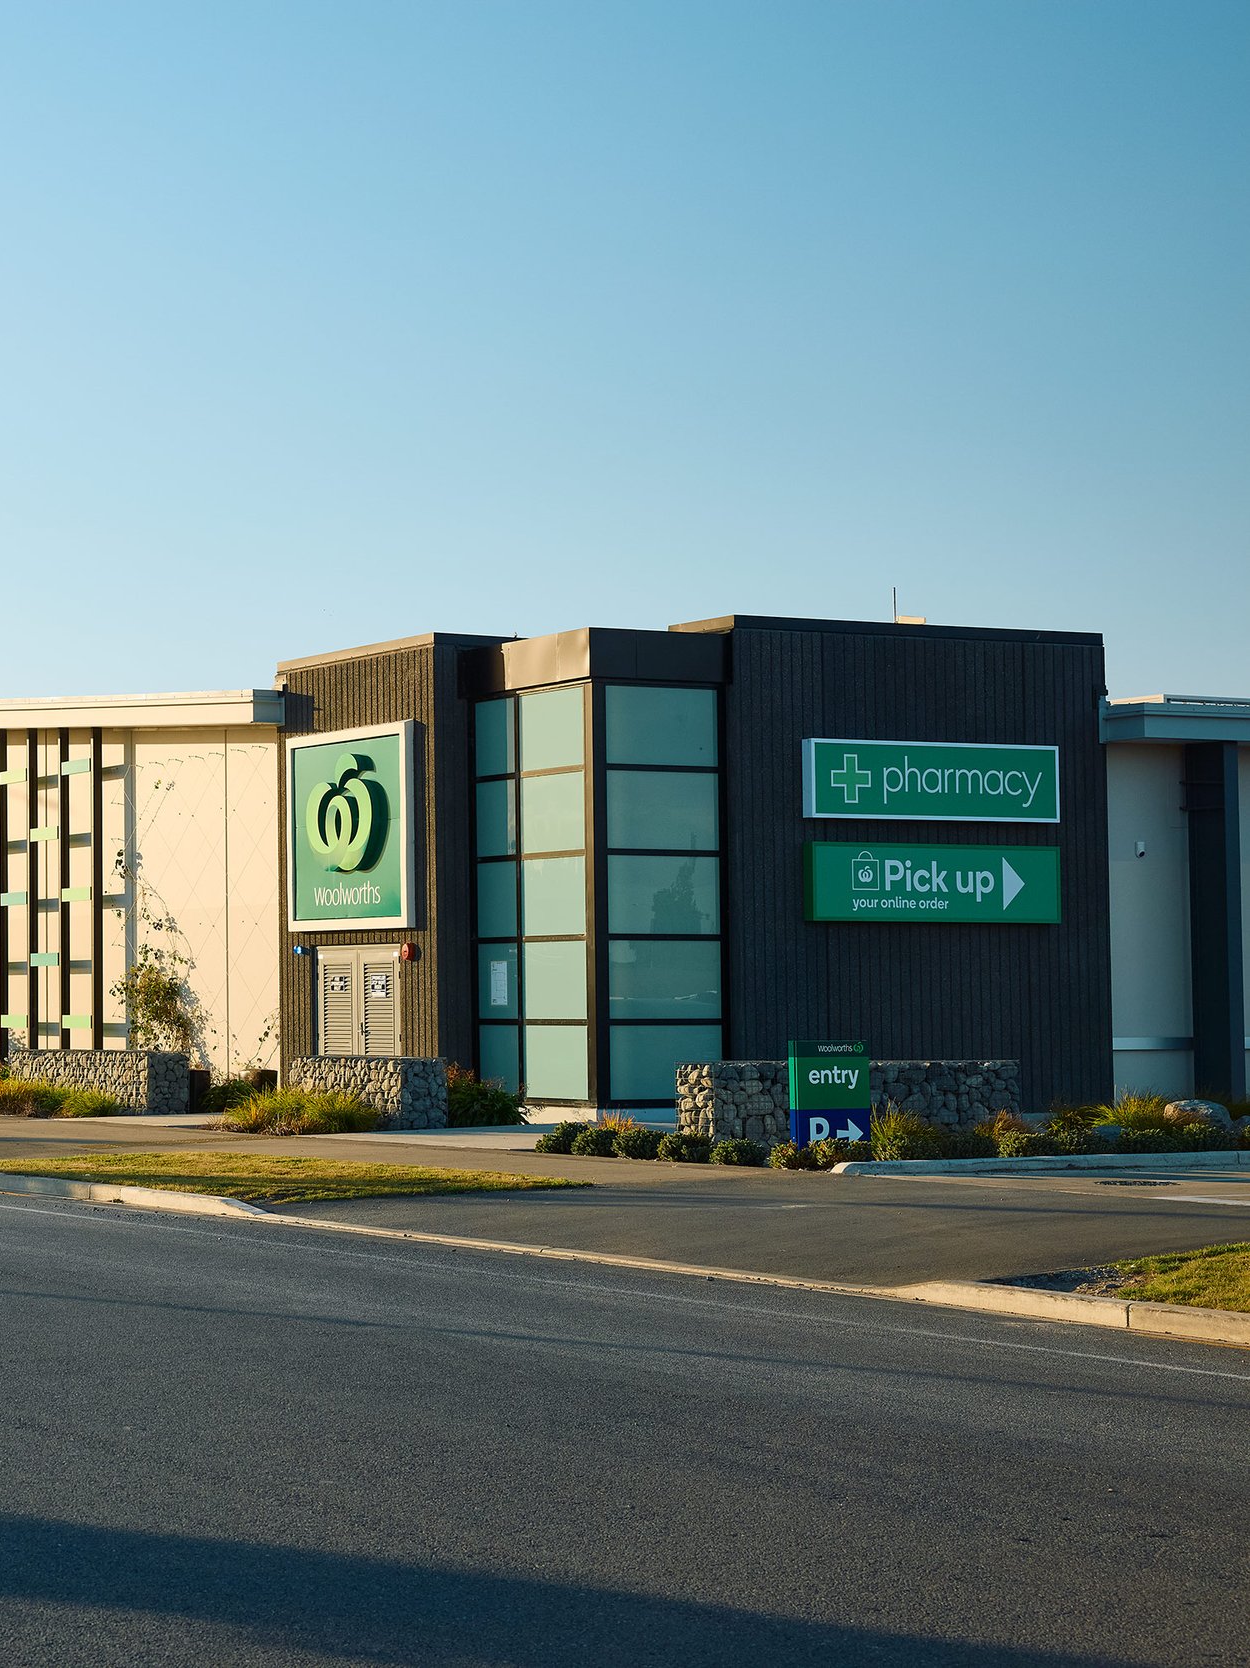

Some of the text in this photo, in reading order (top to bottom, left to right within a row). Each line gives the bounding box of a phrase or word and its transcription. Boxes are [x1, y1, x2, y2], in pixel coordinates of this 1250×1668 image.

[883, 755, 1043, 808] pharmacy
[884, 859, 995, 902] Pick up
[852, 896, 949, 911] your online order
[808, 1065, 859, 1090] entry
